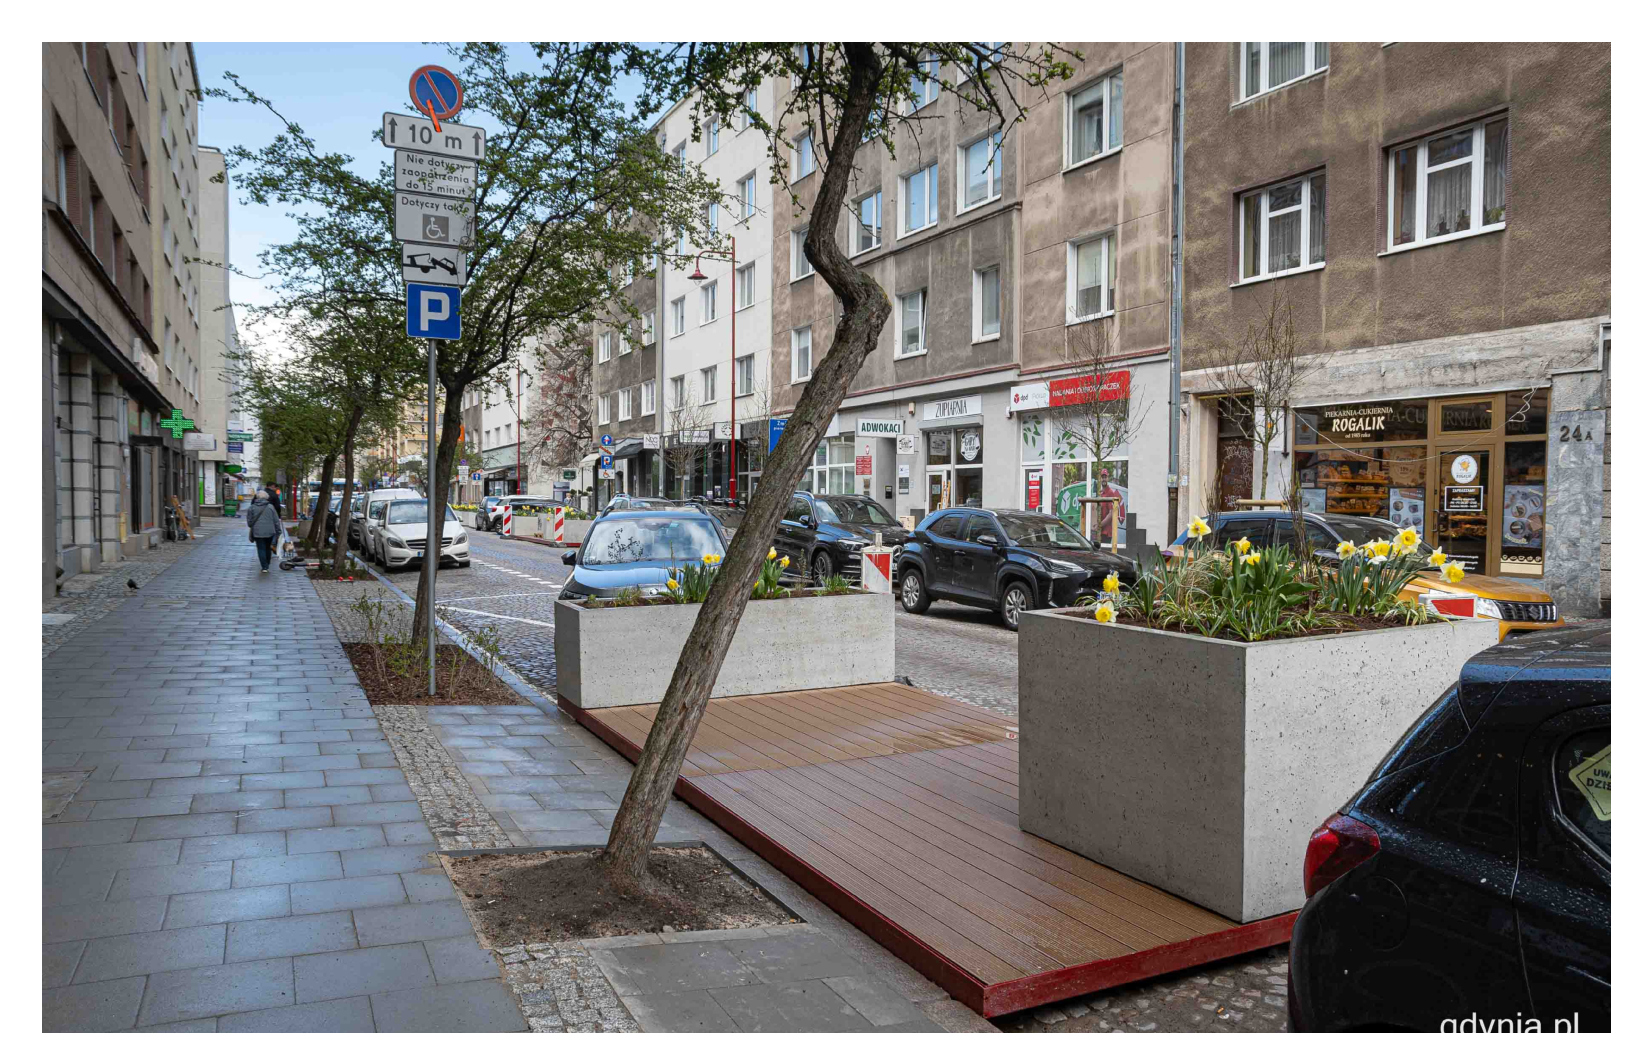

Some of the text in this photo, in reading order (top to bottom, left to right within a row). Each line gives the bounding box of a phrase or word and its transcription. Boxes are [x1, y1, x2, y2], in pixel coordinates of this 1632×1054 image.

[409, 124, 462, 149] 10 m
[407, 154, 465, 173] Nie dotyczy
[402, 168, 469, 184] zaopatrzenia
[406, 181, 466, 195] do 15 minut
[402, 196, 440, 212] Dotyczy
[420, 290, 450, 331] P
[1020, 393, 1029, 403] dpd
[935, 400, 968, 418] ZUPIARNIA
[1325, 406, 1394, 418] PIEKARNIA-CUKIERNIA
[861, 422, 901, 434] ADWOKACI
[1332, 416, 1385, 433] ROGALIK
[1593, 768, 1611, 778] UW
